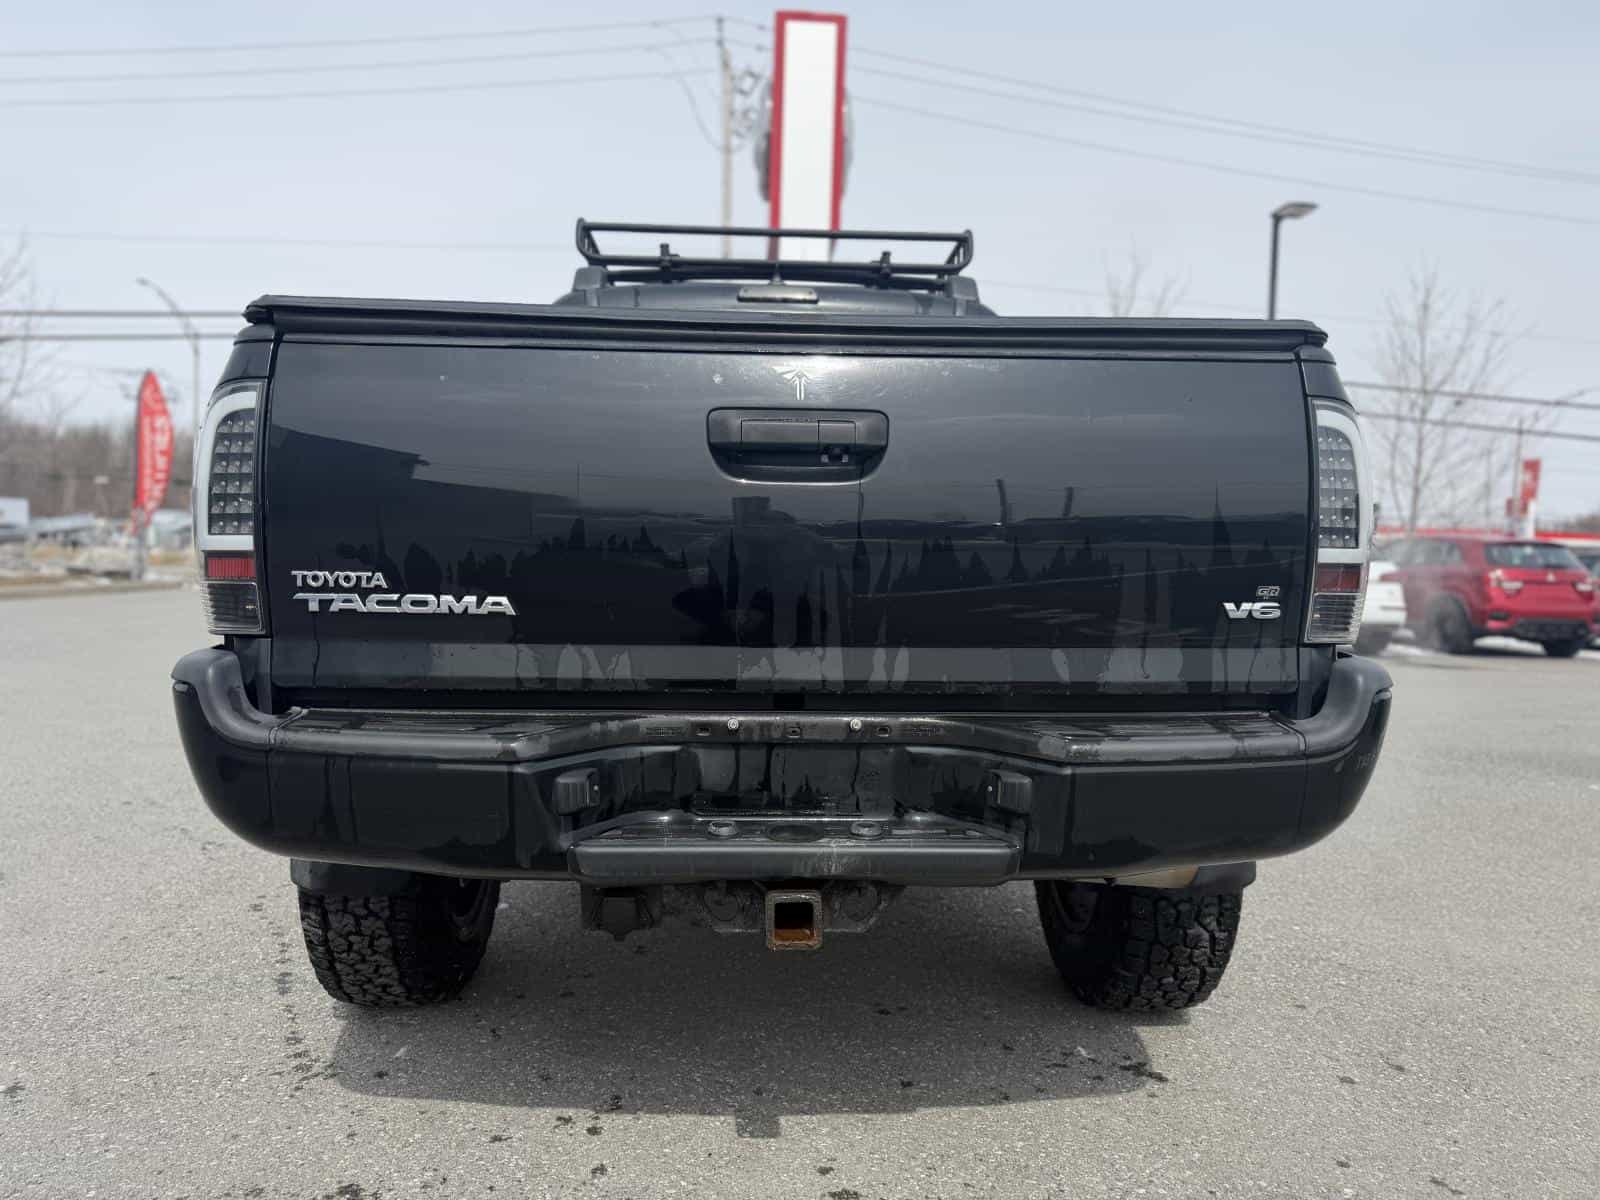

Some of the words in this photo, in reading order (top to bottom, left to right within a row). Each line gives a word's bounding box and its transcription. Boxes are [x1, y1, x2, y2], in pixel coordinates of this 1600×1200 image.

[291, 570, 388, 589] TOYOTA
[292, 592, 517, 616] TACOMA
[1222, 601, 1282, 620] V6
